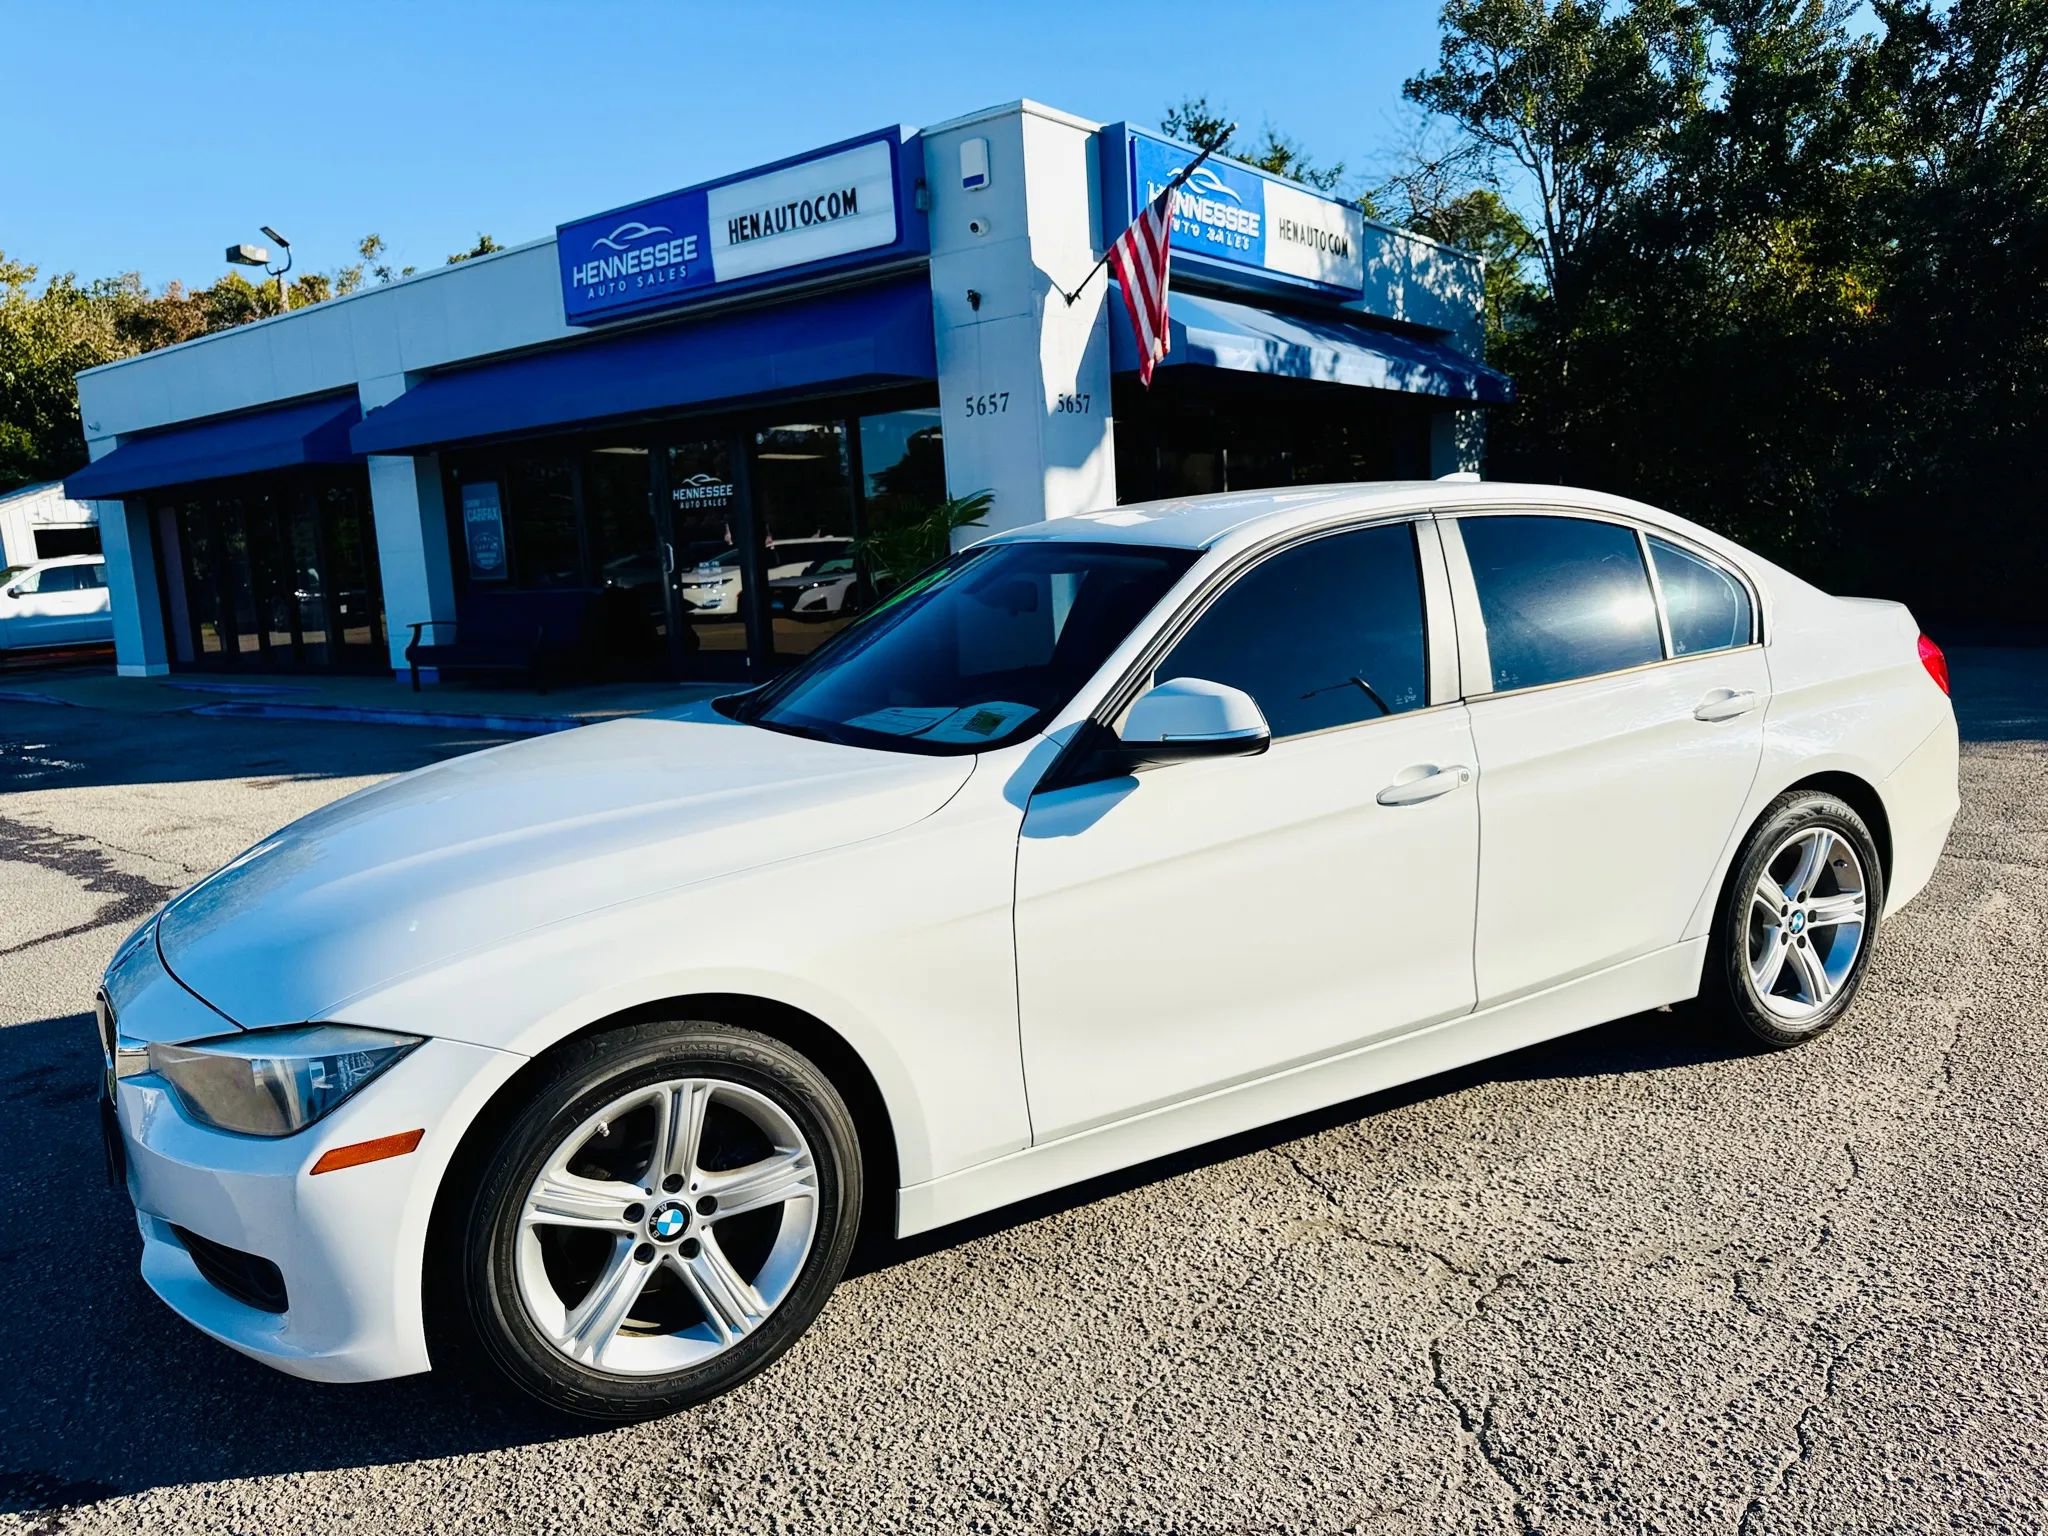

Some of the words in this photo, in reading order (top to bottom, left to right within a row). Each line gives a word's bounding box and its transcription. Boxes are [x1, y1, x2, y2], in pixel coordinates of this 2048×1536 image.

[728, 187, 859, 246] HENAUTO.COM
[1170, 216, 1200, 237] UTO
[1207, 224, 1250, 251] SALES
[573, 234, 698, 289] HENNESSEE
[587, 279, 627, 300] AUTO
[636, 265, 688, 288] SALES
[965, 391, 1010, 417] 5657
[1057, 394, 1091, 415] 5657
[672, 484, 734, 501] HENNESSEE
[679, 500, 701, 510] AUTO
[703, 497, 728, 507] SALES
[466, 507, 499, 522] CARFAX
